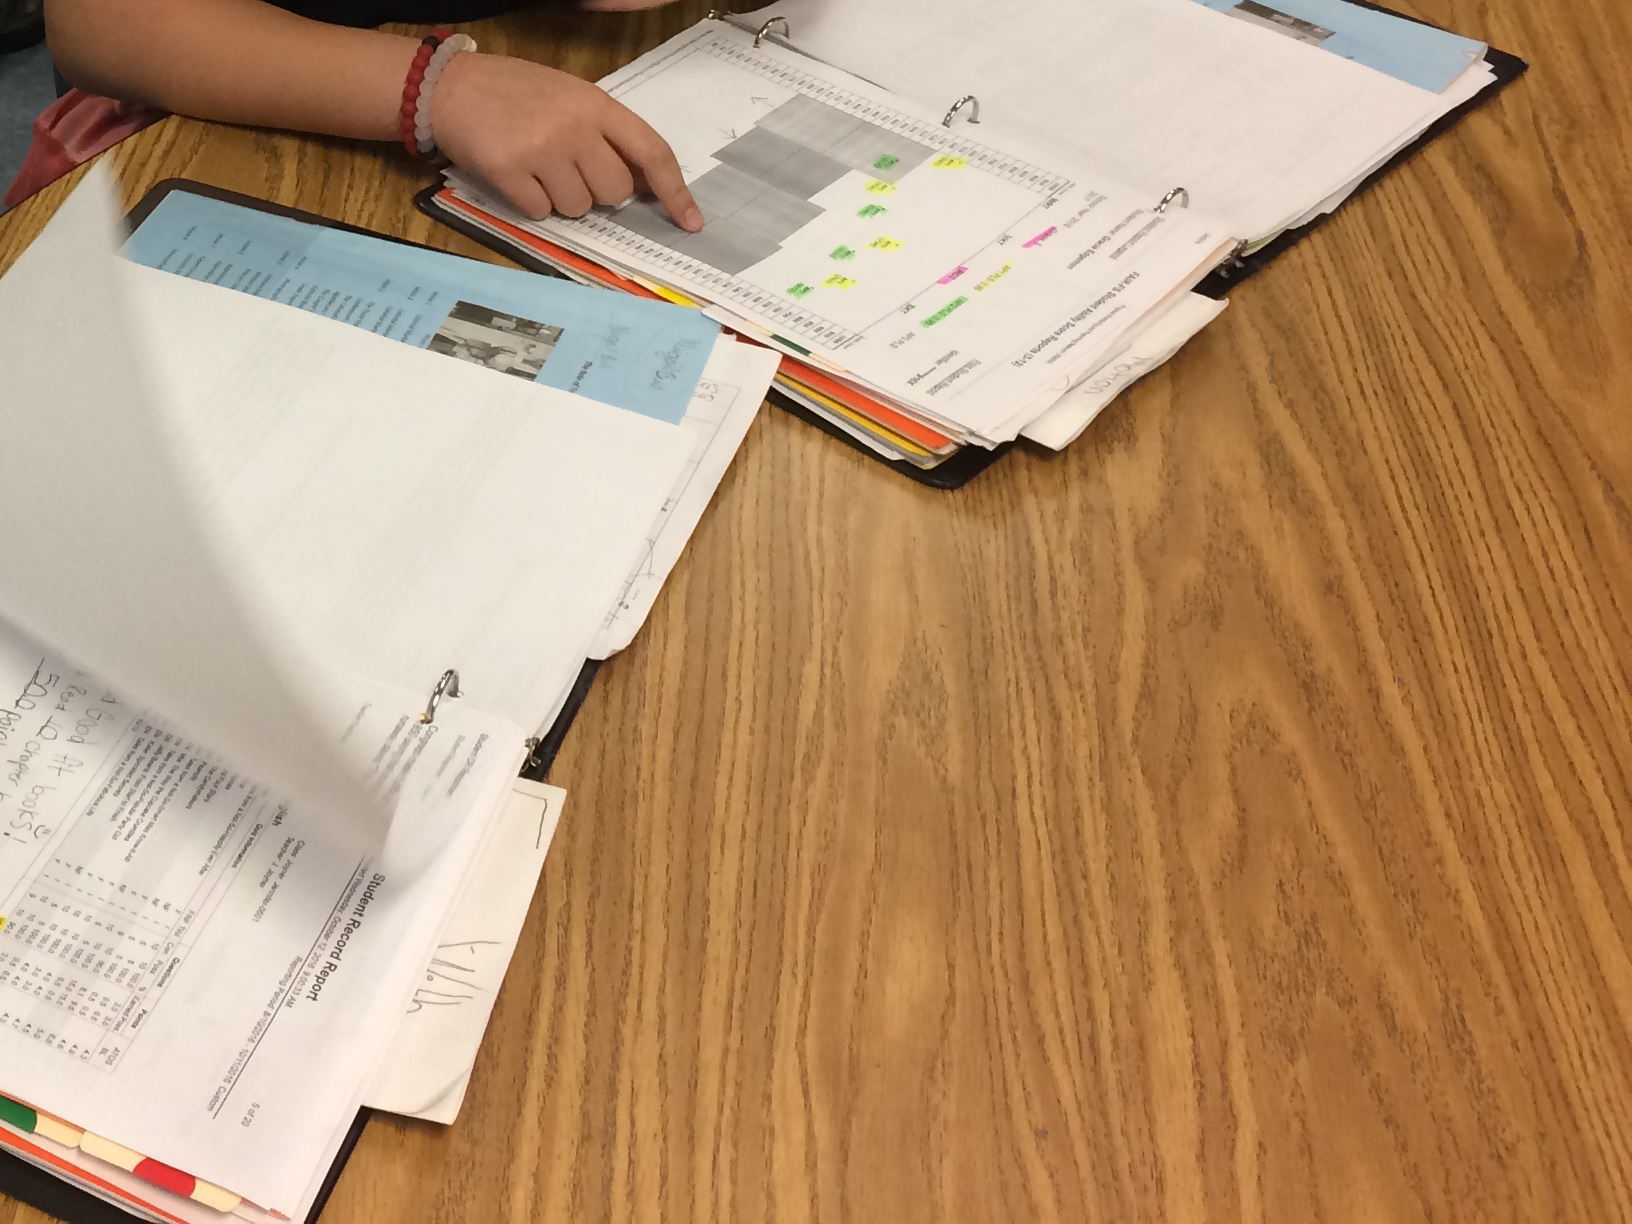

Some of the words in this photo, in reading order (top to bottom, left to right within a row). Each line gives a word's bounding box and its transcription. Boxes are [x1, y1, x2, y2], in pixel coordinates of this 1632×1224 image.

[6, 740, 40, 786] chapter
[352, 872, 385, 917] Student
[329, 917, 361, 960] Record
[305, 960, 337, 1001] Report
